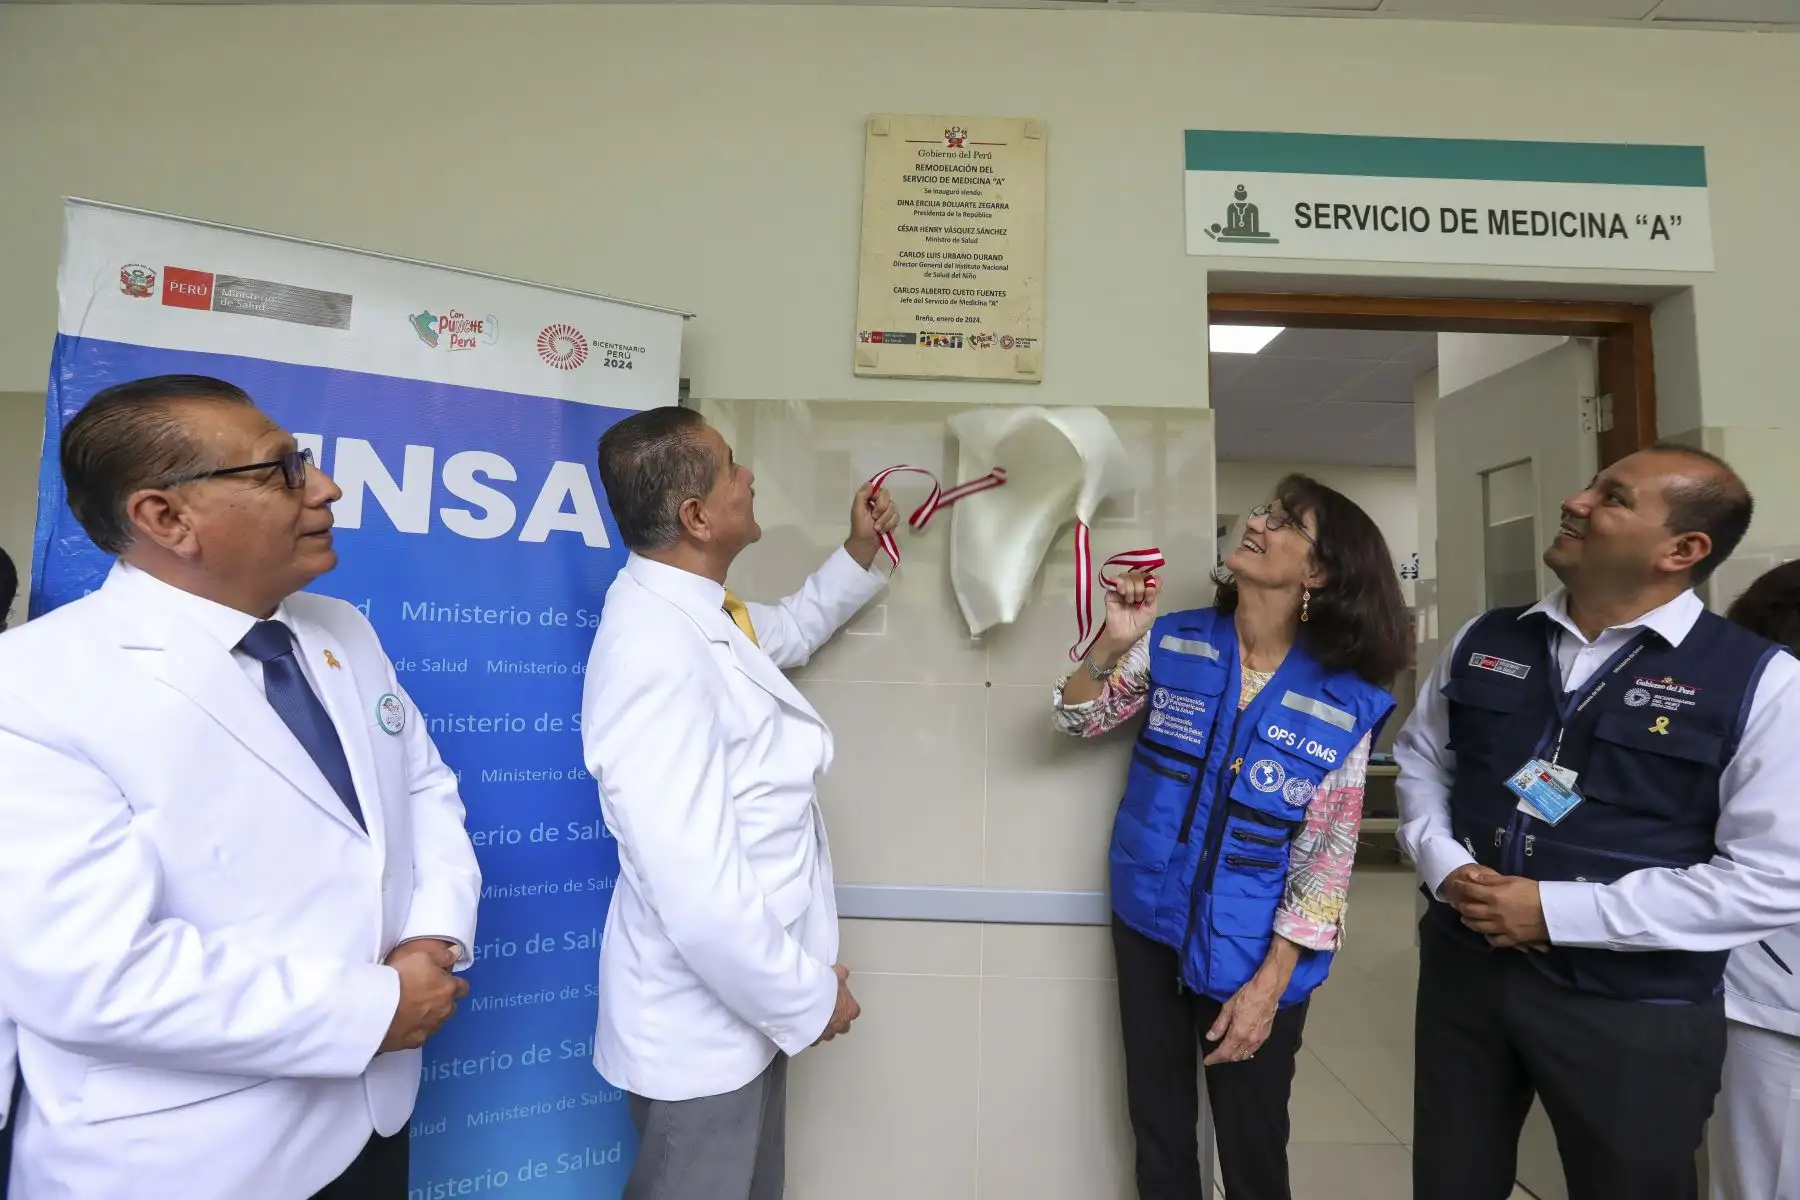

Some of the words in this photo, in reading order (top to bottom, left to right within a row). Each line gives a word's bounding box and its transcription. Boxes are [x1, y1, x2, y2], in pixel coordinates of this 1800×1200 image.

[918, 150, 956, 158] Gobierno
[959, 150, 971, 159] del
[973, 151, 992, 160] Perú
[915, 164, 978, 173] REMODELACIÓN
[902, 175, 937, 184] SERVICIO
[952, 176, 991, 185] MEDICINA
[933, 188, 959, 196] inauguró
[963, 211, 992, 219] República
[1294, 202, 1430, 234] SERVICIO
[1439, 207, 1478, 235] DE
[1486, 209, 1629, 240] MEDICINA
[1635, 214, 1682, 241] “A”
[897, 224, 918, 232] CÉSAR
[944, 226, 974, 235] VÁSQUEZ
[976, 226, 1007, 236] SÁNCHEZ
[170, 280, 207, 296] PERÚ
[450, 309, 464, 319] Con
[915, 314, 935, 323] Breña,
[439, 316, 484, 334] PUNCHE
[450, 334, 476, 348] Perú
[592, 340, 646, 353] BICENTENARIO
[607, 350, 631, 360] PERÚ
[603, 358, 633, 370] 2024
[292, 432, 610, 548] NSA
[402, 601, 531, 626] Ministerio
[540, 607, 568, 627] de
[395, 658, 417, 672] de
[422, 658, 468, 672] Salud
[487, 660, 567, 675] Ministerio
[1636, 679, 1666, 689] Gobierno
[1678, 686, 1695, 695] Perú
[424, 713, 526, 733] inisterio
[534, 713, 563, 732] de
[1268, 726, 1296, 746] OPS
[1297, 738, 1305, 749] /
[1306, 741, 1337, 763] OMS
[482, 768, 563, 782] Ministerio
[568, 766, 586, 780] de
[529, 822, 559, 843] de
[567, 820, 613, 842] Salu
[480, 882, 558, 899] Ministerio
[564, 880, 582, 892] de
[588, 876, 618, 891] Salu
[525, 934, 554, 954] de
[562, 928, 602, 951] Sal
[471, 990, 554, 1012] Ministerio
[560, 985, 579, 1000] de
[422, 1050, 513, 1082] nisterio
[521, 1044, 551, 1065] de
[559, 1036, 592, 1059] Sal
[467, 1102, 551, 1128] Ministerio
[556, 1096, 576, 1111] de
[409, 1116, 446, 1138] alud
[409, 1168, 508, 1200] nisterio
[518, 1160, 548, 1182] de
[556, 1142, 621, 1174] Salud
